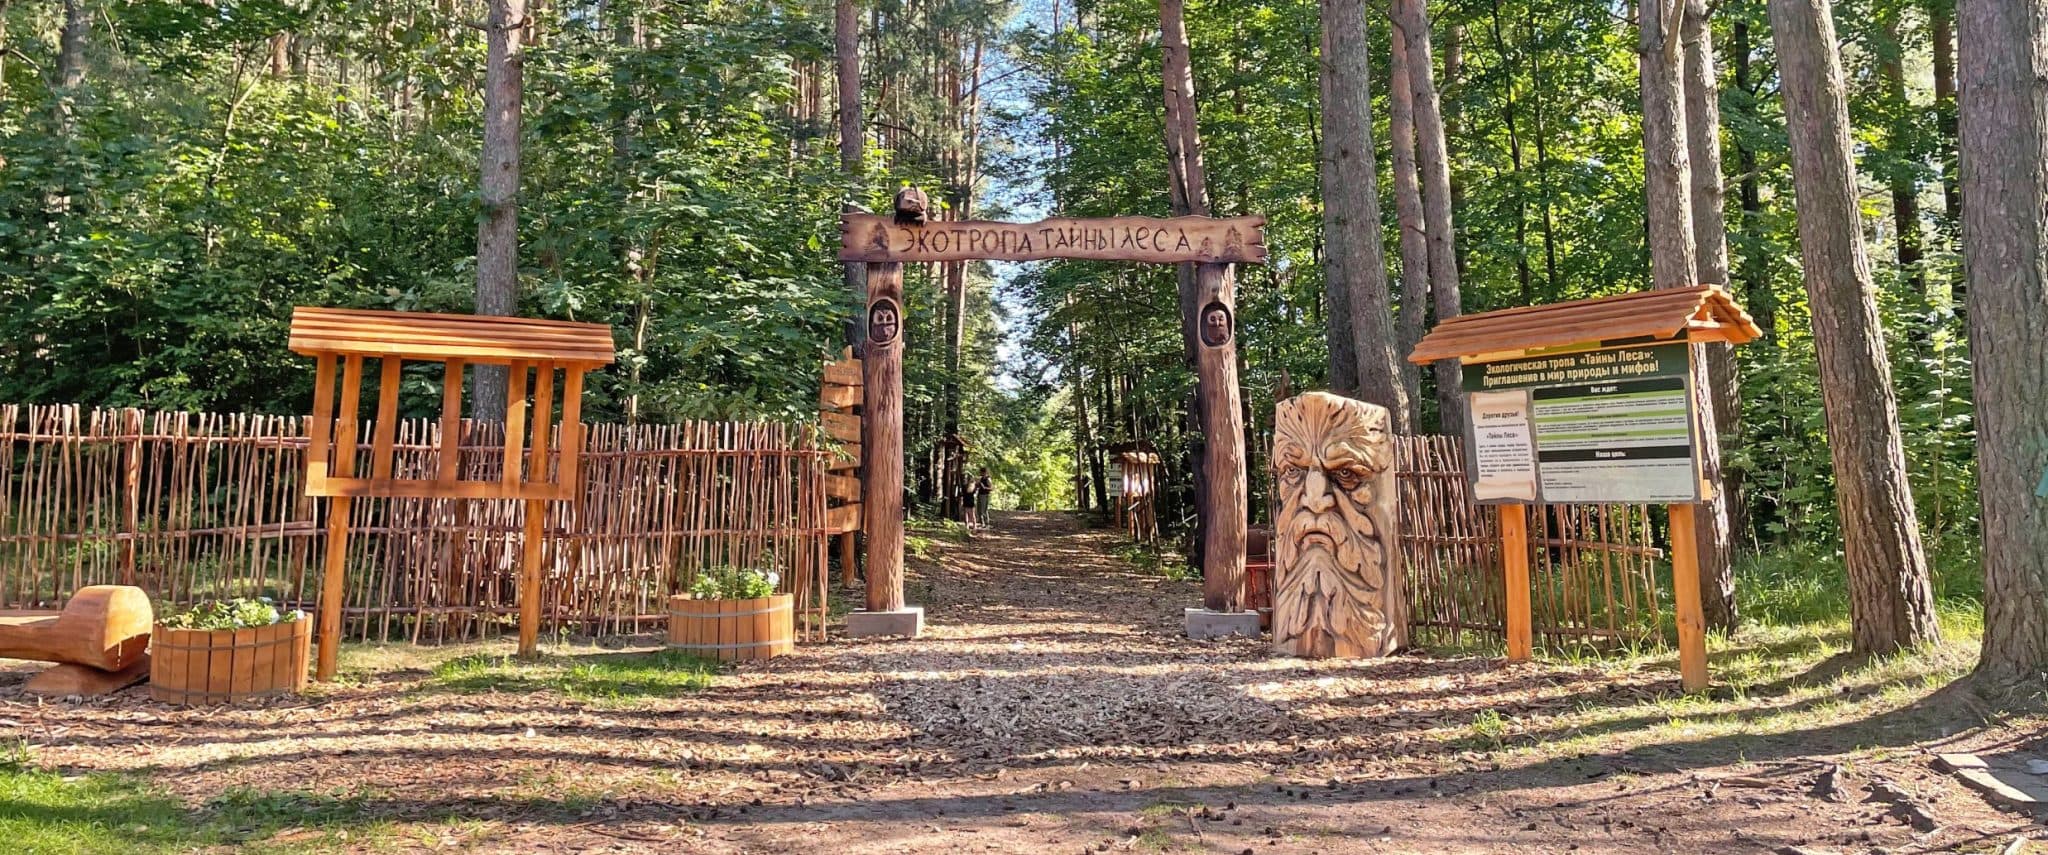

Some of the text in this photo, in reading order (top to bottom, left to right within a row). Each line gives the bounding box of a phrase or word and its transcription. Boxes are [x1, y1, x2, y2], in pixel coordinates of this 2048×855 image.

[899, 227, 1032, 253] ЭКОТРОПА
[1039, 221, 1115, 250] ТАЙНЫ
[1483, 373, 1539, 387] Приглашение
[1547, 371, 1565, 382] мир
[1567, 367, 1610, 381] природы
[1611, 365, 1619, 375] и
[1621, 360, 1659, 375] мифов!
[1486, 350, 1654, 375] Экологическая тропа «Тайны Леса»:
